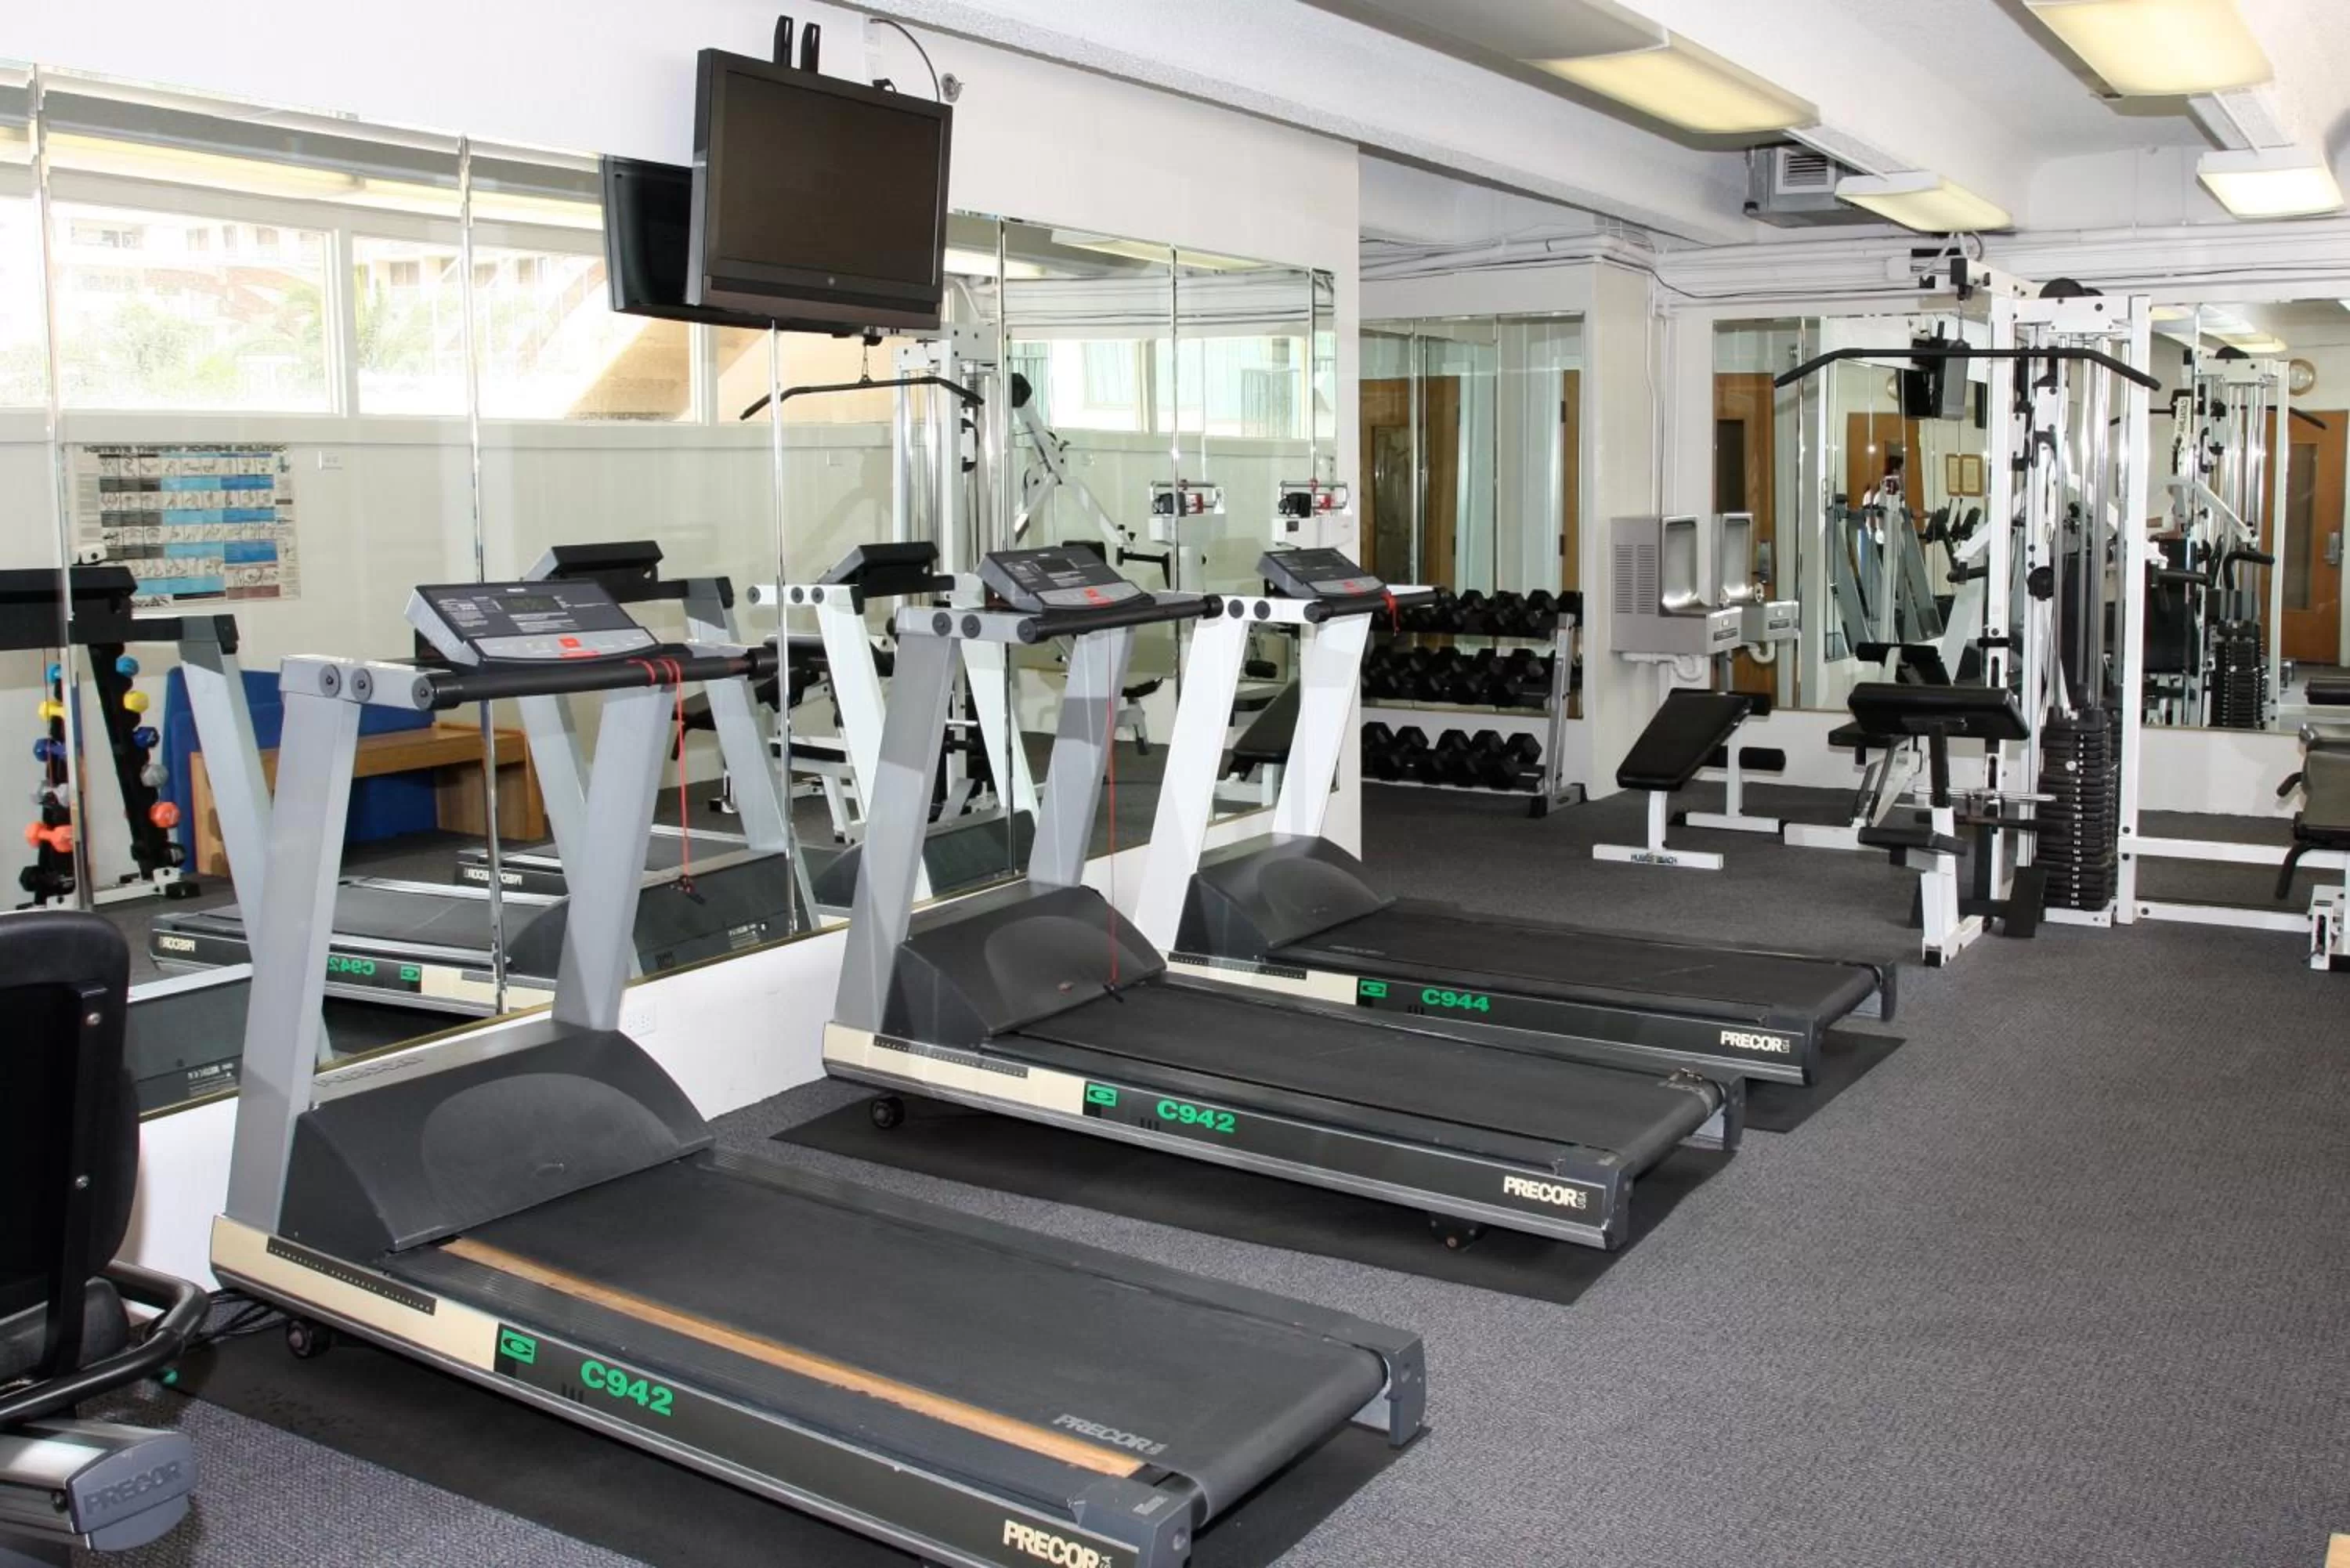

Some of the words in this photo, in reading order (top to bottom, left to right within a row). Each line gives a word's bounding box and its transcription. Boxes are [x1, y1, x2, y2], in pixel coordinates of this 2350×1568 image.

[1423, 988, 1490, 1012] C944
[1720, 1031, 1782, 1052] PRECOR
[1157, 1100, 1235, 1133] C942
[1503, 1176, 1578, 1207] PRECOR
[580, 1360, 674, 1417] C942
[1053, 1413, 1153, 1451] PRECOR
[83, 1459, 182, 1515] PRECOR
[1003, 1519, 1099, 1568] PRECOR
